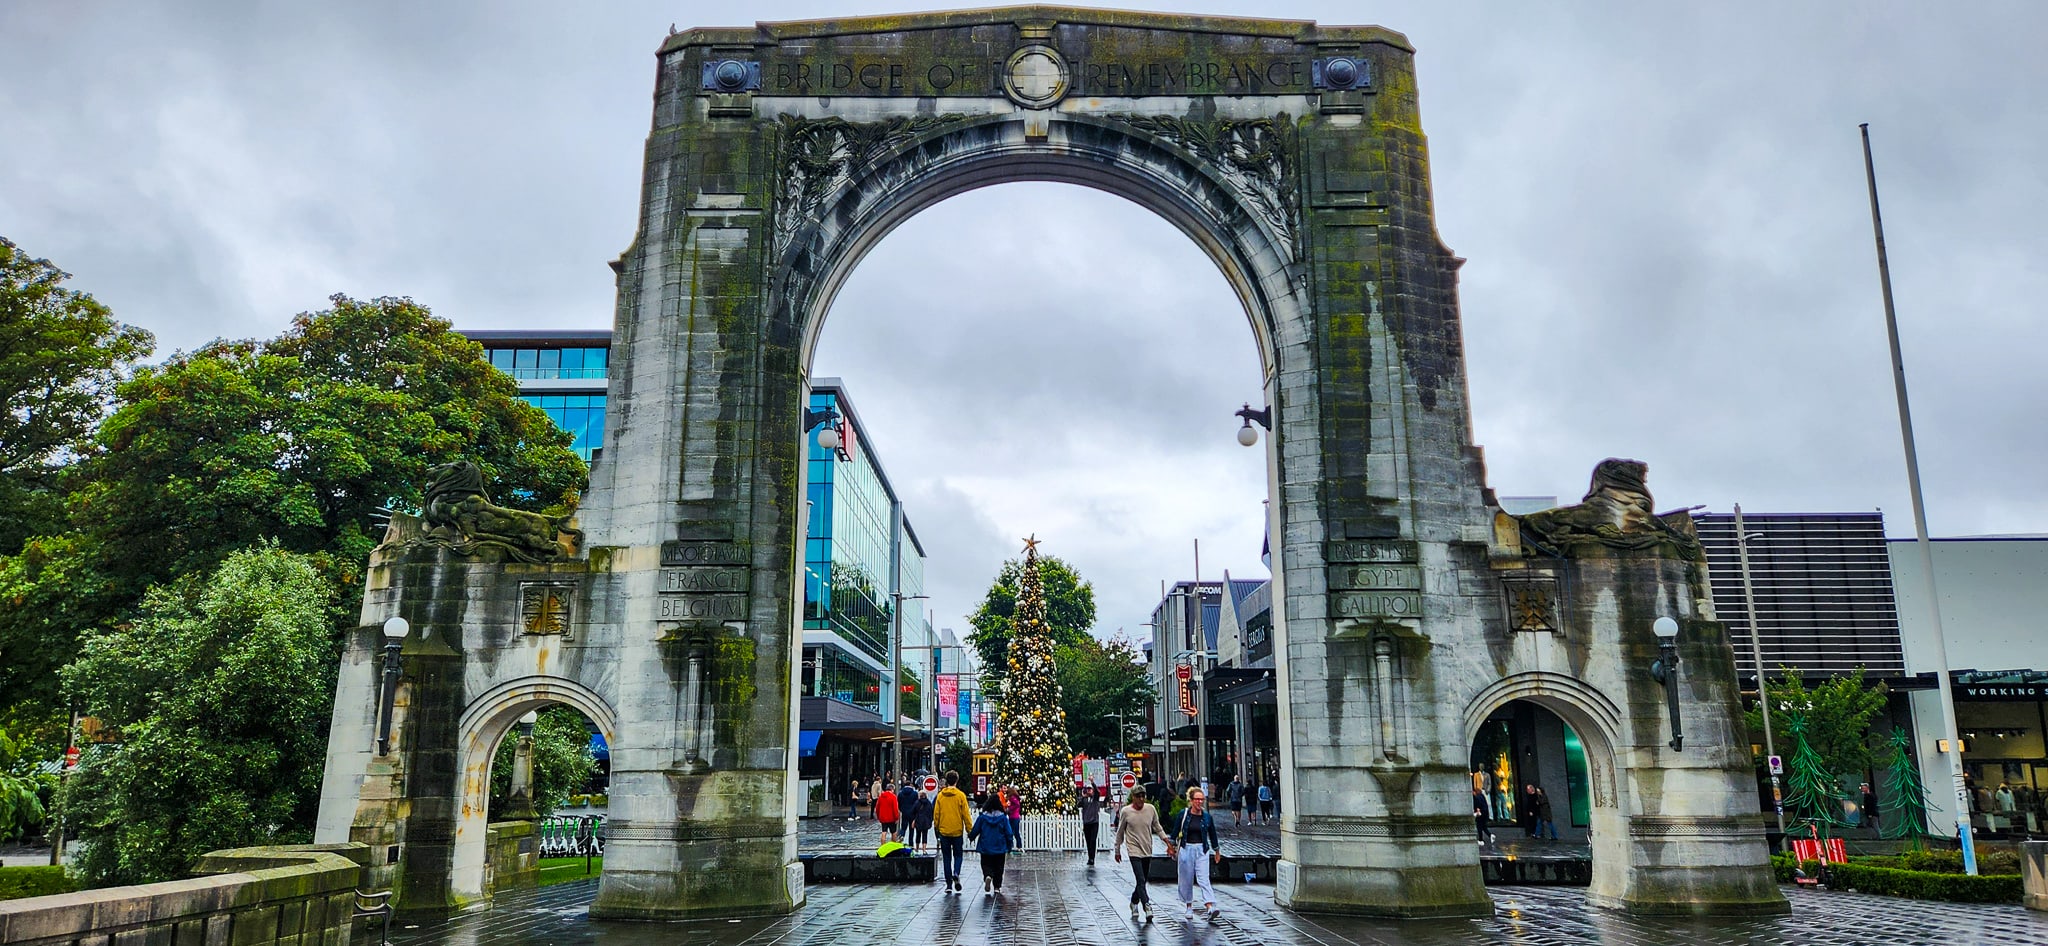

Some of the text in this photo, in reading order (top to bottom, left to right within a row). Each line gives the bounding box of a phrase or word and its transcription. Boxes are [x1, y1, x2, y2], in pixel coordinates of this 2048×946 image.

[776, 62, 1305, 90] BRIDGE OF REMEMBRANCE
[1335, 543, 1414, 560] PALESTINE
[668, 572, 739, 589] FRANCE
[1347, 569, 1402, 587] EGYPT
[661, 599, 742, 617] BELGIUM
[1335, 596, 1420, 614] GALLIPOLI
[1967, 688, 2036, 696] WORKING
